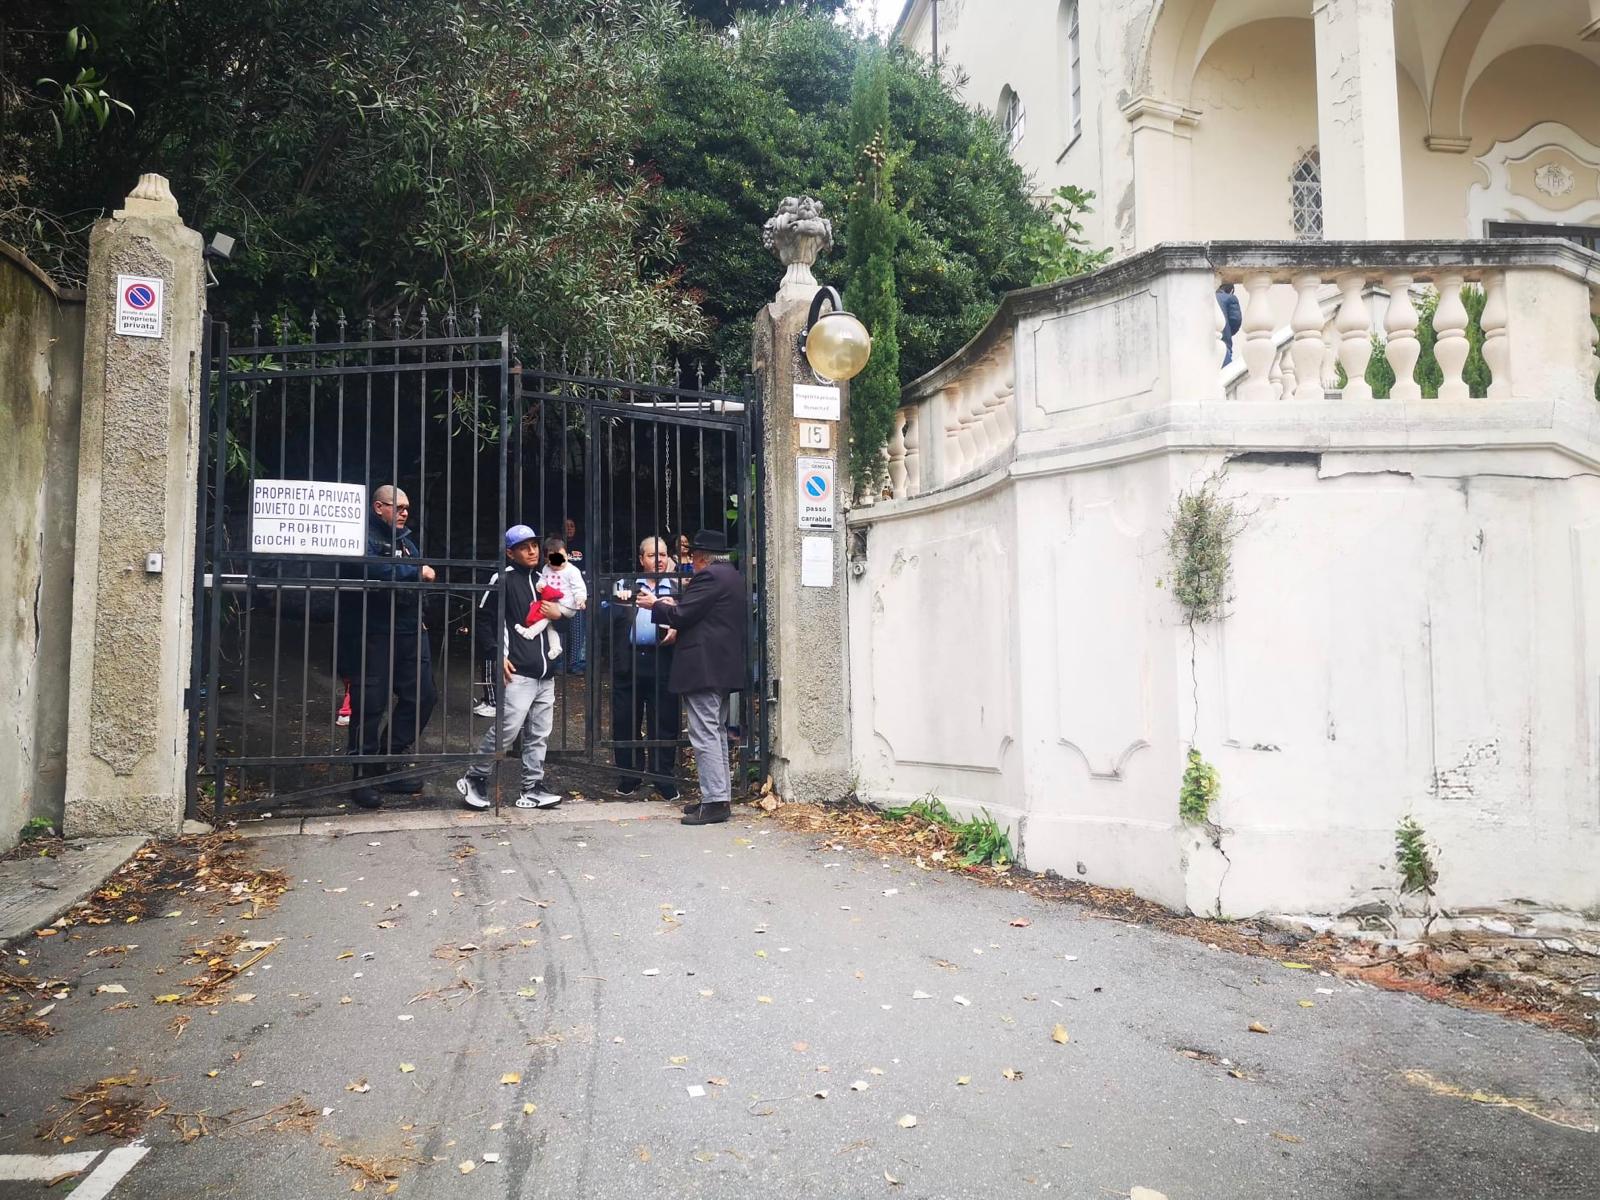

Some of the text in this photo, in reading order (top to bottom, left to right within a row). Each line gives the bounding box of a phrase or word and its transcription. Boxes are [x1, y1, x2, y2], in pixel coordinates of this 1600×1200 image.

[807, 426, 822, 444] 15
[318, 489, 361, 505] PRIVATA
[254, 502, 361, 520] DIVIETO DI ACCESSO
[801, 515, 832, 523] carrabile
[279, 522, 336, 535] PROIBITI
[254, 535, 360, 550] GIOCHI e RUMORI
